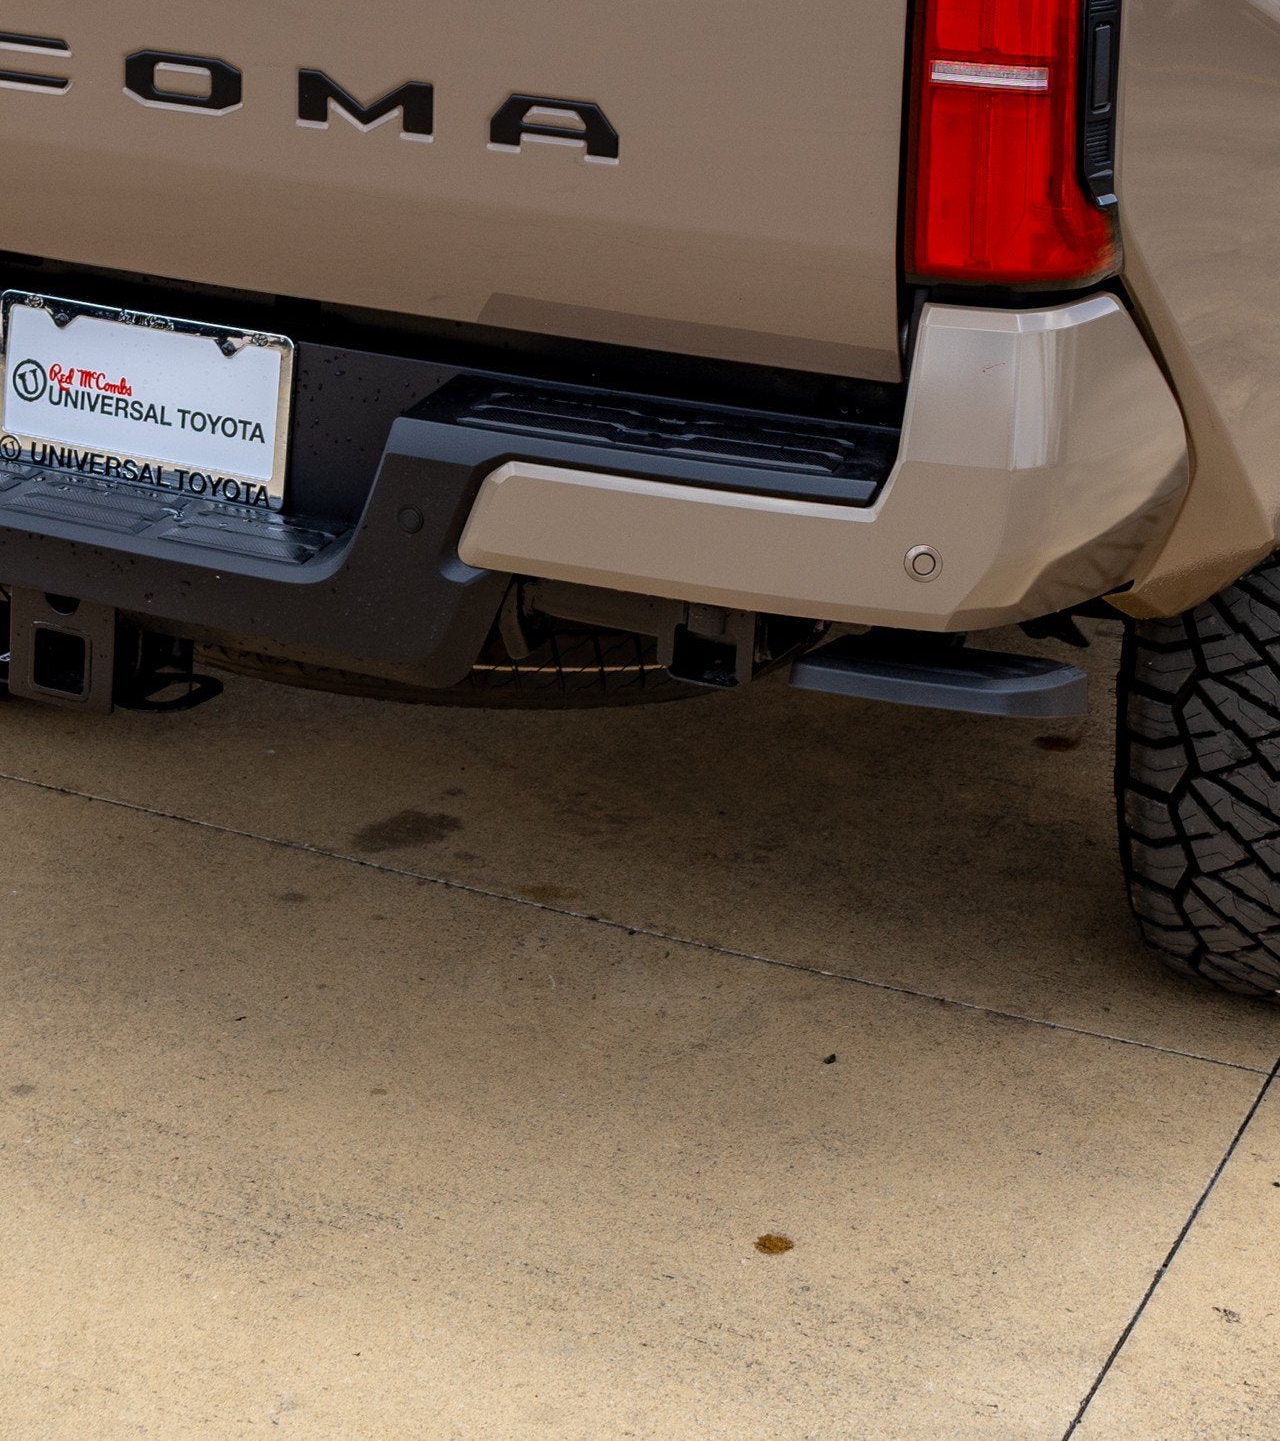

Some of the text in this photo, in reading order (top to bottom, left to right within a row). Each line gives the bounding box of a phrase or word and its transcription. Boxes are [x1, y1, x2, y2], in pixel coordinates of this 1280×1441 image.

[49, 363, 133, 397] Red McCombs
[48, 385, 266, 444] UNIVERSAL TOYOTA
[30, 441, 271, 508] UNIVERSAL TOYOTA
